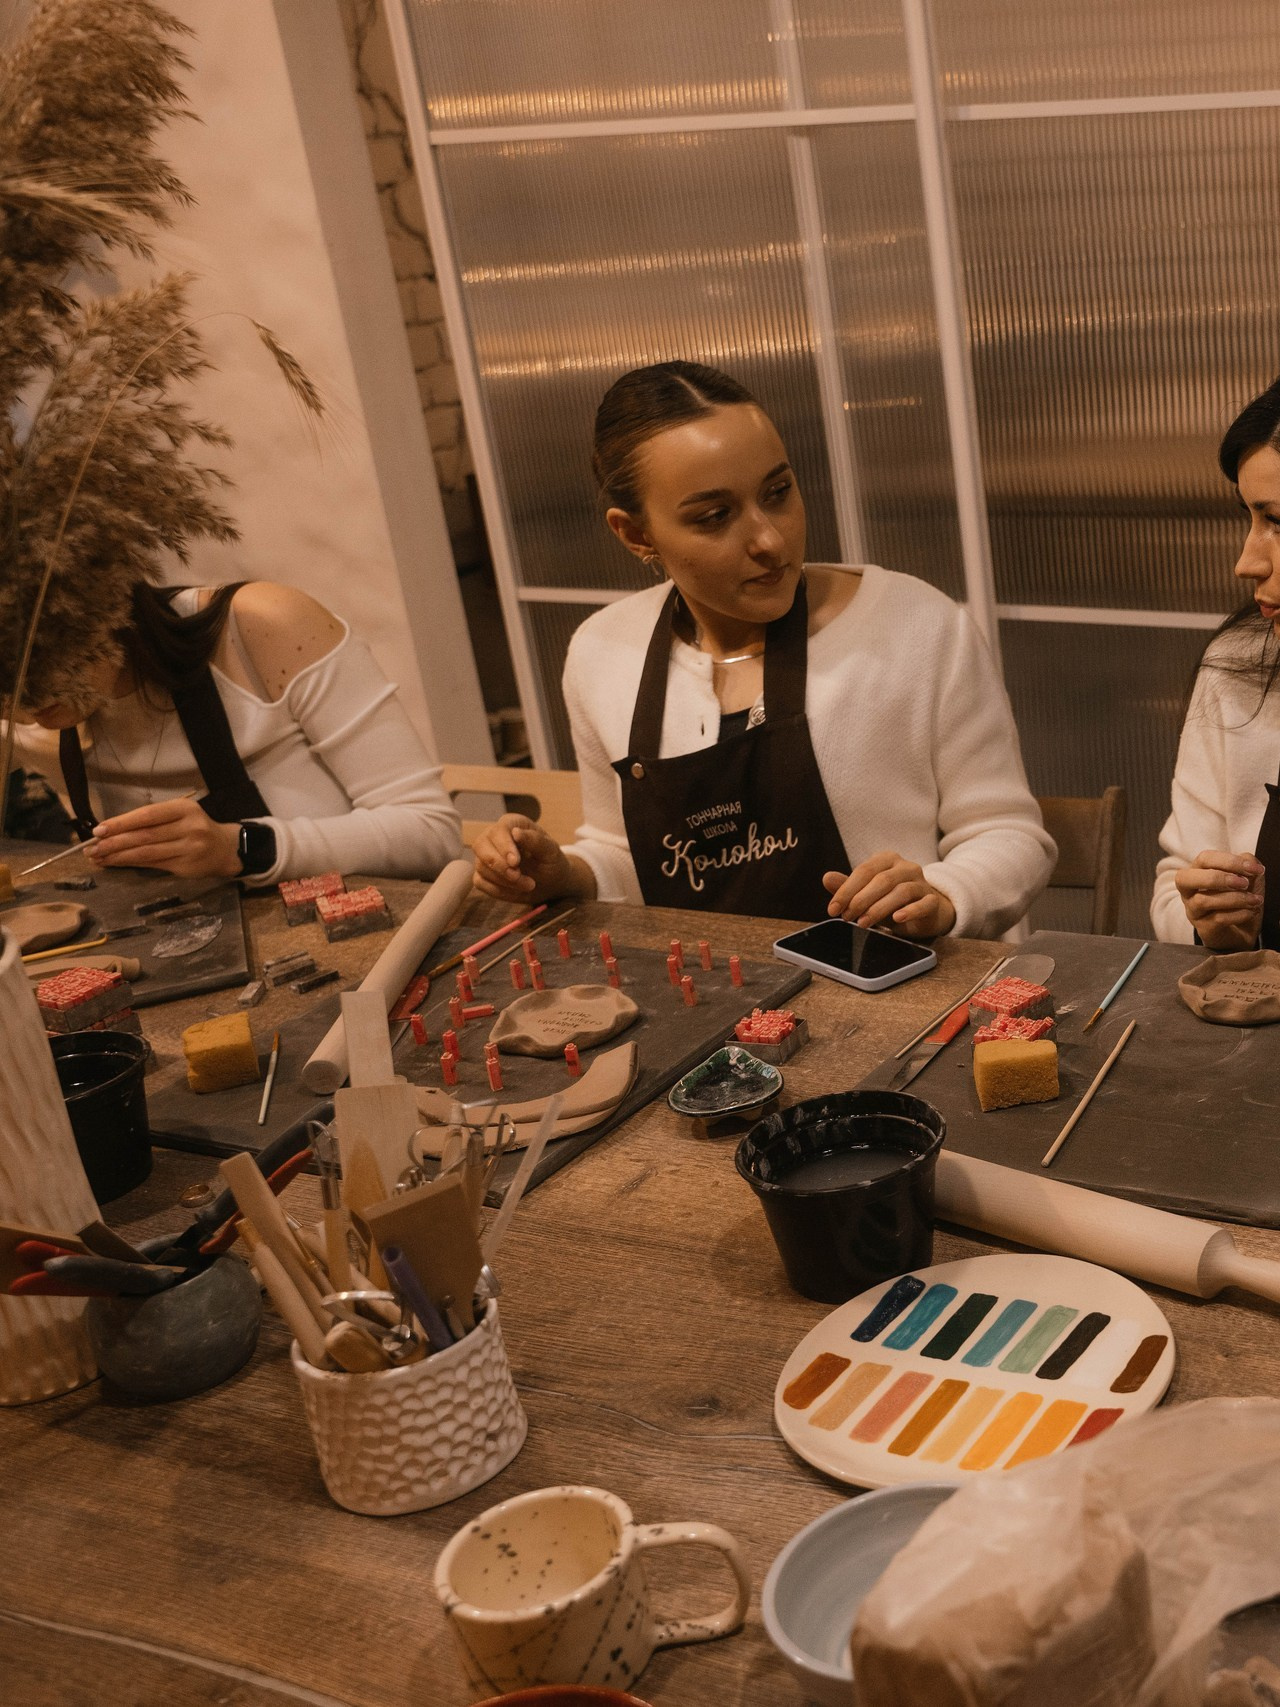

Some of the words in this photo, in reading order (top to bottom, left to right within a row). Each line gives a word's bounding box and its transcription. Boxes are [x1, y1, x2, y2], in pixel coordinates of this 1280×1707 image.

[686, 801, 742, 829] ГОНЧАРНАЯ
[702, 820, 738, 840] ШКОЛА
[661, 822, 799, 892] Колокол
